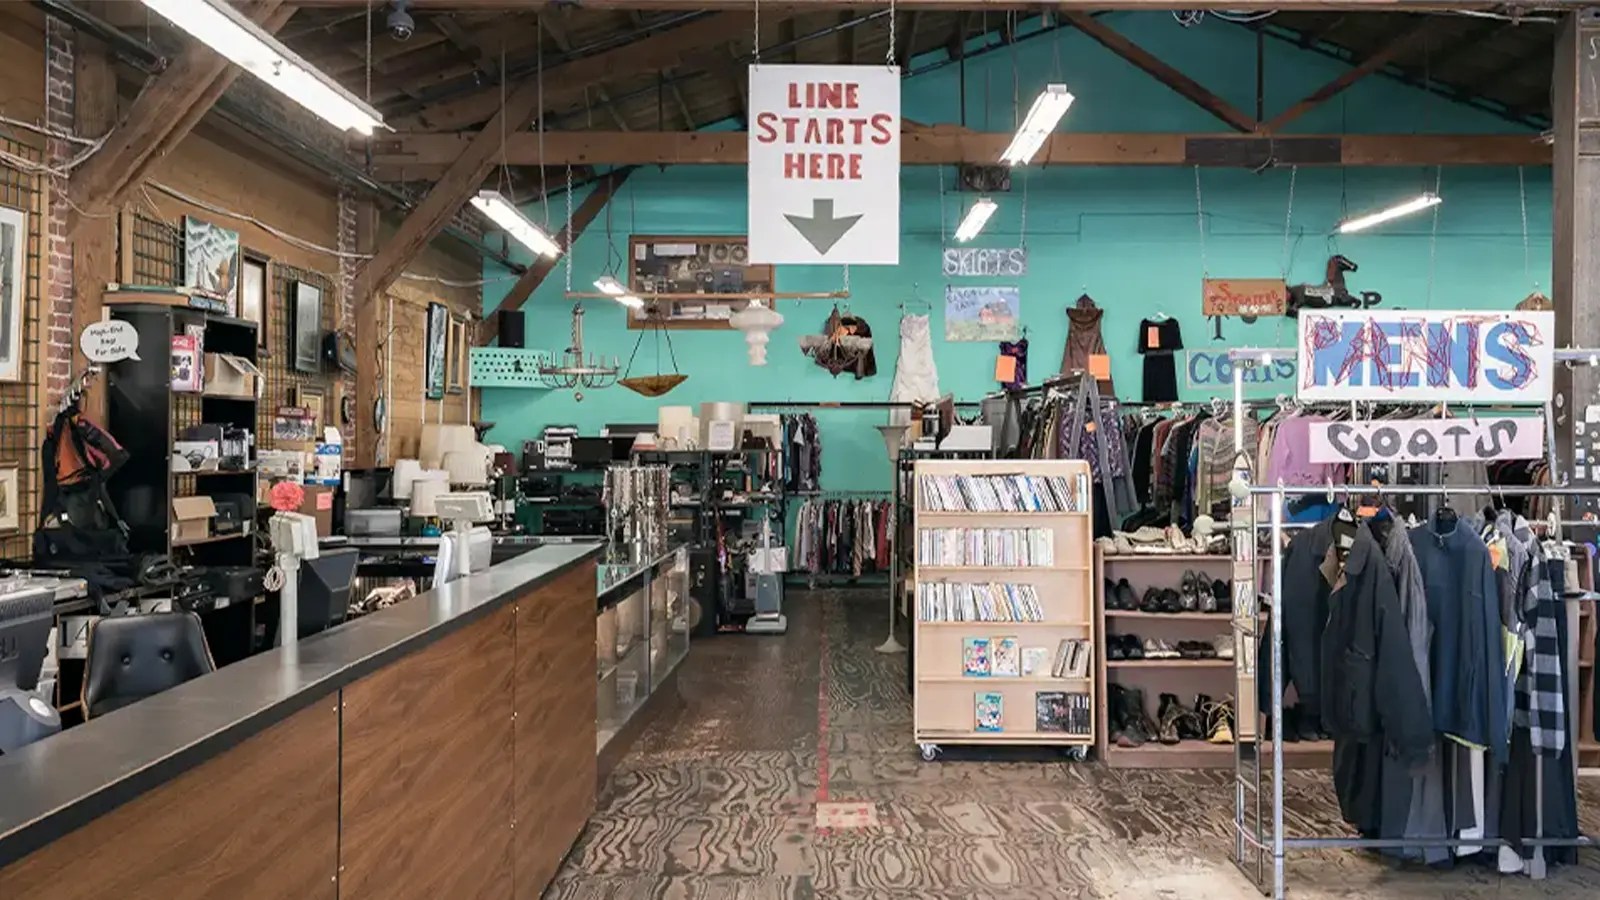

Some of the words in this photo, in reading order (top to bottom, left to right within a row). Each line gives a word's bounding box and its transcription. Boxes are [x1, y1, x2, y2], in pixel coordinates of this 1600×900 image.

[788, 82, 859, 108] LINE
[757, 112, 893, 145] STARTS
[784, 153, 862, 179] HERE
[944, 248, 1024, 275] SKIRTS
[1313, 321, 1532, 391] MENS
[1327, 419, 1518, 460] COATS
